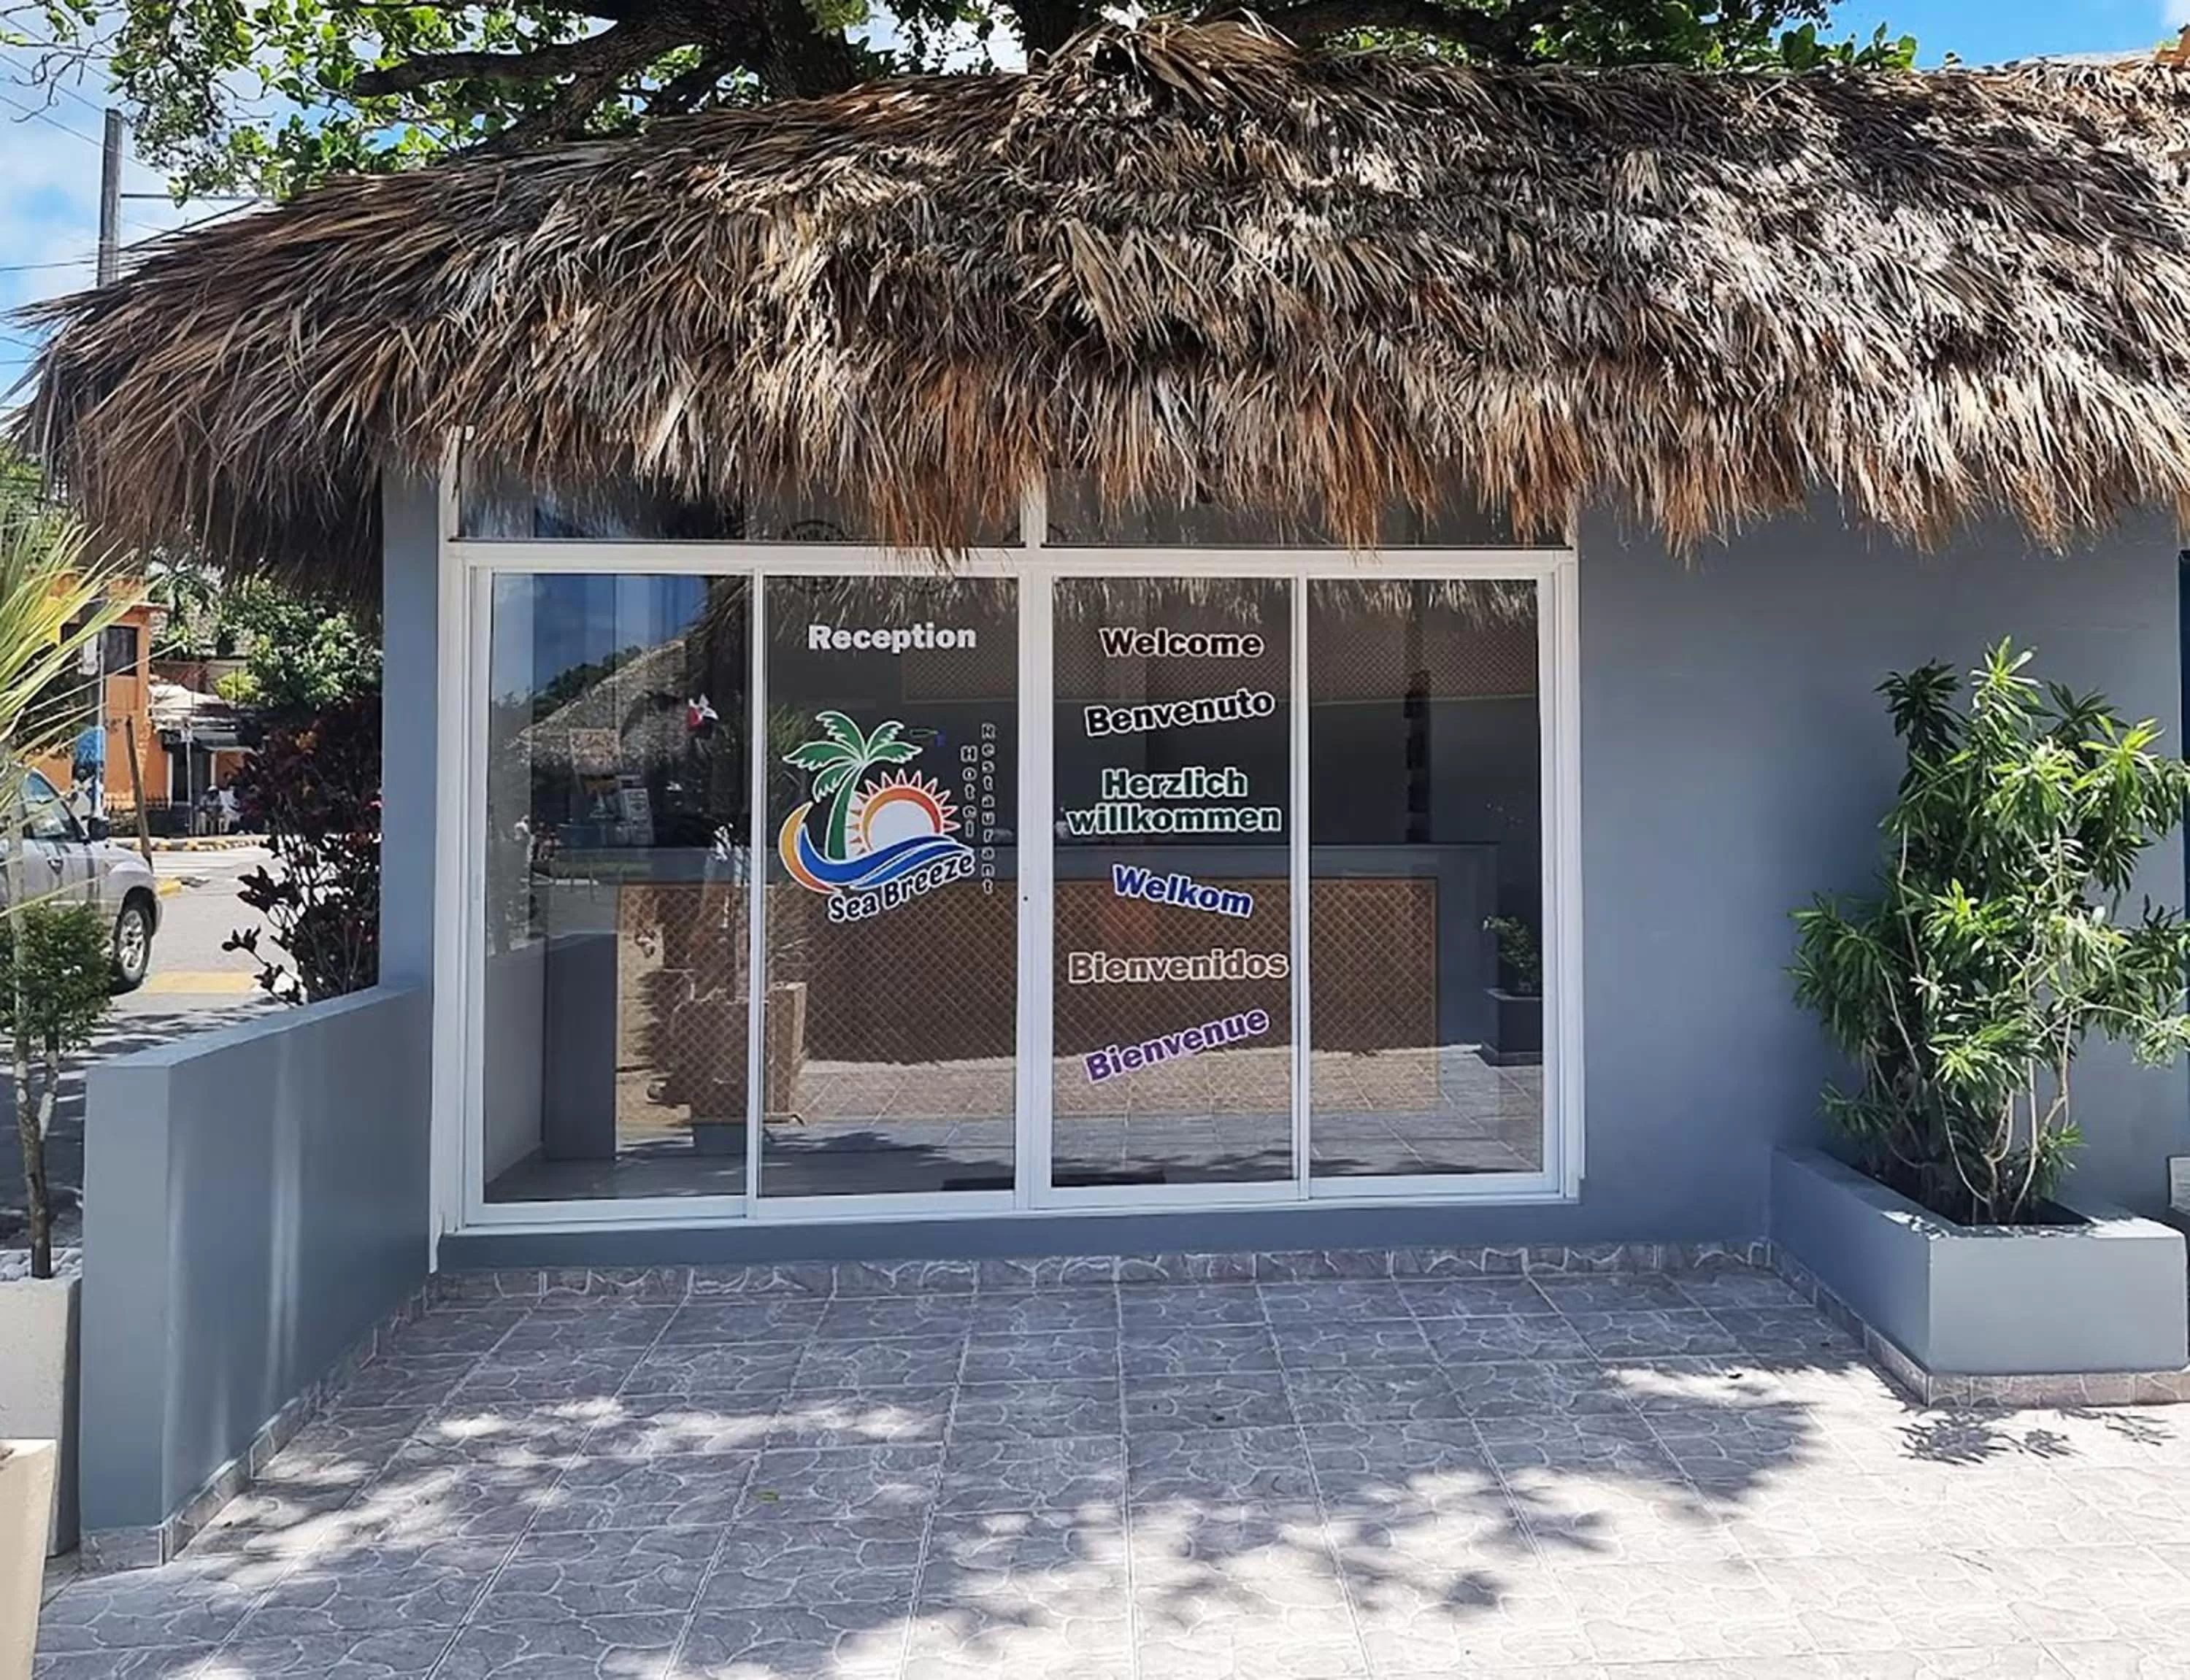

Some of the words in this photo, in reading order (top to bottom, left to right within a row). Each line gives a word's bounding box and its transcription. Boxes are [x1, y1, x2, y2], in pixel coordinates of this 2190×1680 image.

[808, 622, 977, 654] Reception
[1099, 627, 1264, 658] Welcome
[1084, 687, 1276, 736] Benvenuto
[960, 745, 978, 839] Hotel
[1102, 766, 1248, 799] Herzlich
[981, 723, 996, 895] Restaurant
[1066, 803, 1282, 835] willkommen
[828, 893, 880, 922] Sea
[880, 850, 975, 911] Breeze
[1113, 864, 1253, 919] Welkom
[1069, 949, 1290, 984] Bienvenidos
[1085, 1009, 1270, 1084] Bienvenue
